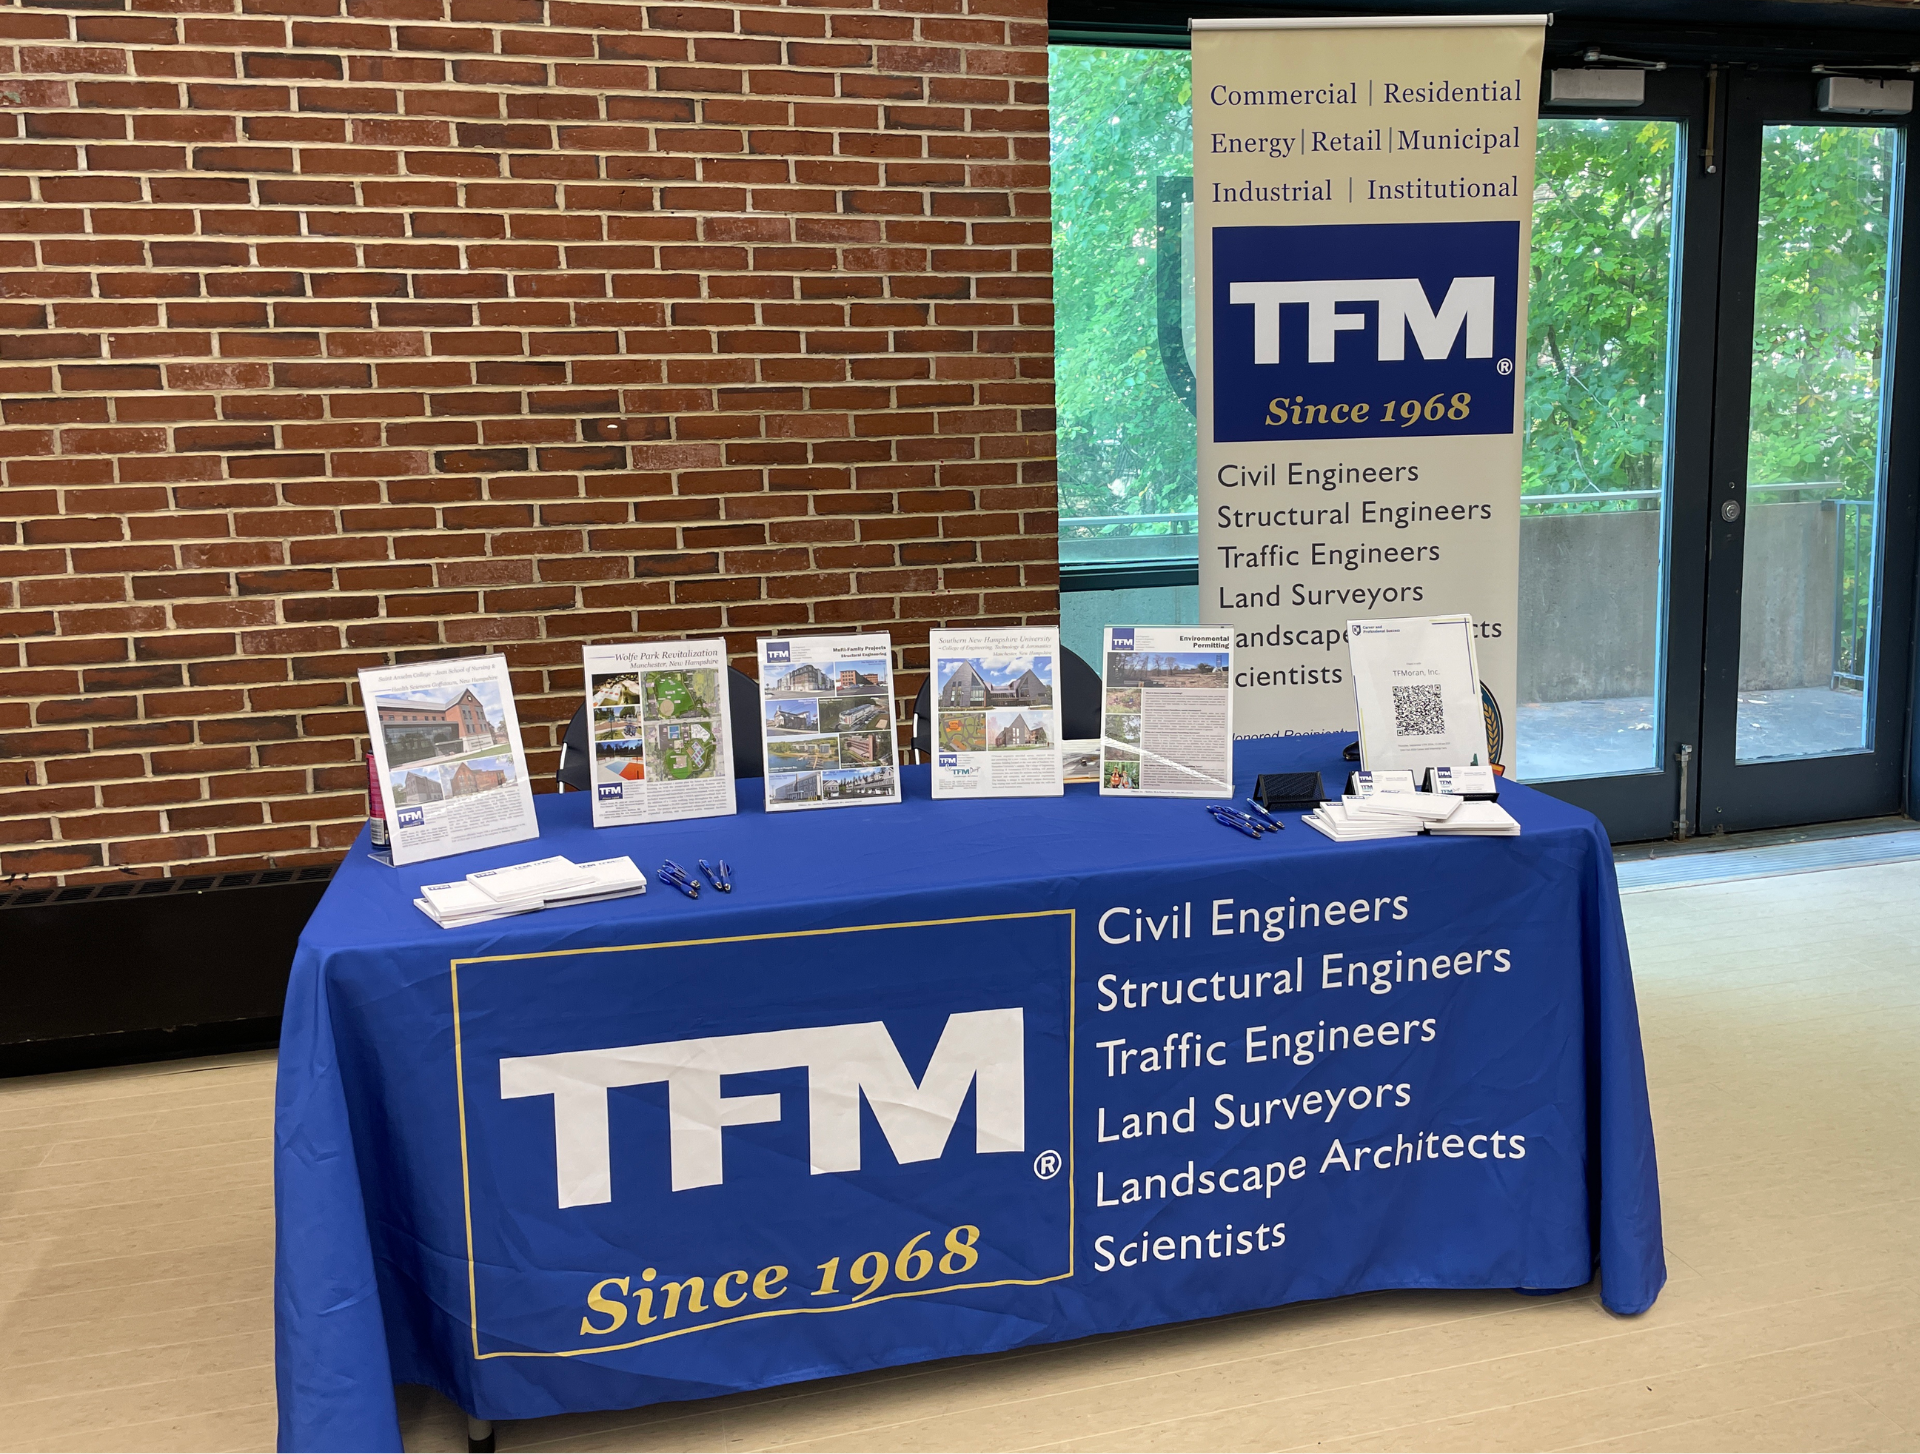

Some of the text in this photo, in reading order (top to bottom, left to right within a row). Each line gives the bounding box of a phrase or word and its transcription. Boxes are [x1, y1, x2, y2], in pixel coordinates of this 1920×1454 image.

[1210, 79, 1522, 106] Commercial Residential
[1211, 126, 1520, 158] Energy Retail Municipal
[1212, 176, 1518, 203] Industrial Institutional
[1265, 391, 1472, 428] Since 1968
[1217, 462, 1420, 491] Civil Engineers
[1217, 500, 1492, 529] Structural Engineers
[1217, 542, 1440, 570] Traffic Engineers
[1219, 582, 1424, 611] Land Surveyors
[768, 650, 789, 658] TFM
[984, 636, 1018, 644] Hampshire
[614, 648, 718, 662] Wolfe Park Revitalization
[684, 658, 719, 667] Hampshire
[1234, 664, 1343, 688] cientists
[599, 786, 622, 796] TFM
[398, 810, 423, 823] TFM
[1098, 895, 1409, 944] Civil Engineers
[1097, 948, 1512, 1012] Structural Engineers
[1096, 1017, 1438, 1078] Traffic Engineers
[1098, 1081, 1412, 1143] Land Surveyors
[1096, 1130, 1527, 1208] Landscape Architects
[1094, 1222, 1288, 1273] Scientists
[578, 1224, 981, 1337] Since 1968
